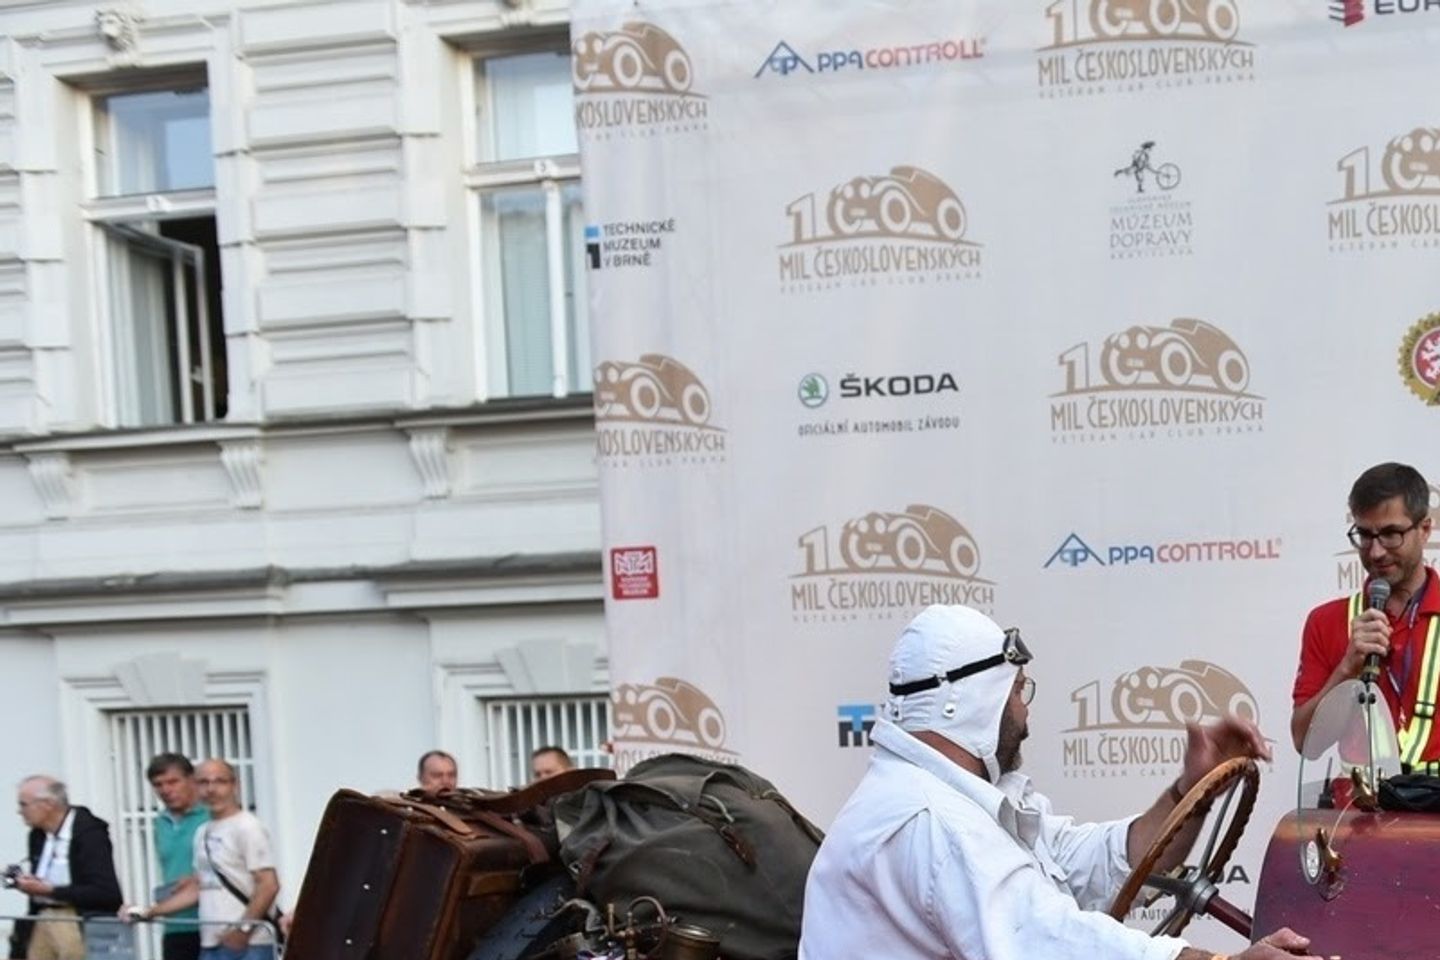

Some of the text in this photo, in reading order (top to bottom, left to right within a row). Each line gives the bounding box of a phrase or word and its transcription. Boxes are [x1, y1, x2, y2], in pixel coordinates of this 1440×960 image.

[1038, 45, 1254, 87] MIL ČESKOSLOVENSKÝCH
[576, 96, 707, 128] KOSLOVENSKÝCH
[1328, 207, 1362, 241] MIL
[780, 244, 981, 281] MIL ČESKOSLOVENSKÝCH
[839, 372, 959, 398] ŠKODA
[1050, 396, 1263, 431] MIL ČESKOSLOVENSKÝCH
[598, 428, 725, 456] OSLOVENSKÝCH
[791, 577, 994, 611] MIL ČESKOSLOVENSKÝCH
[1063, 737, 1095, 766] MIL
